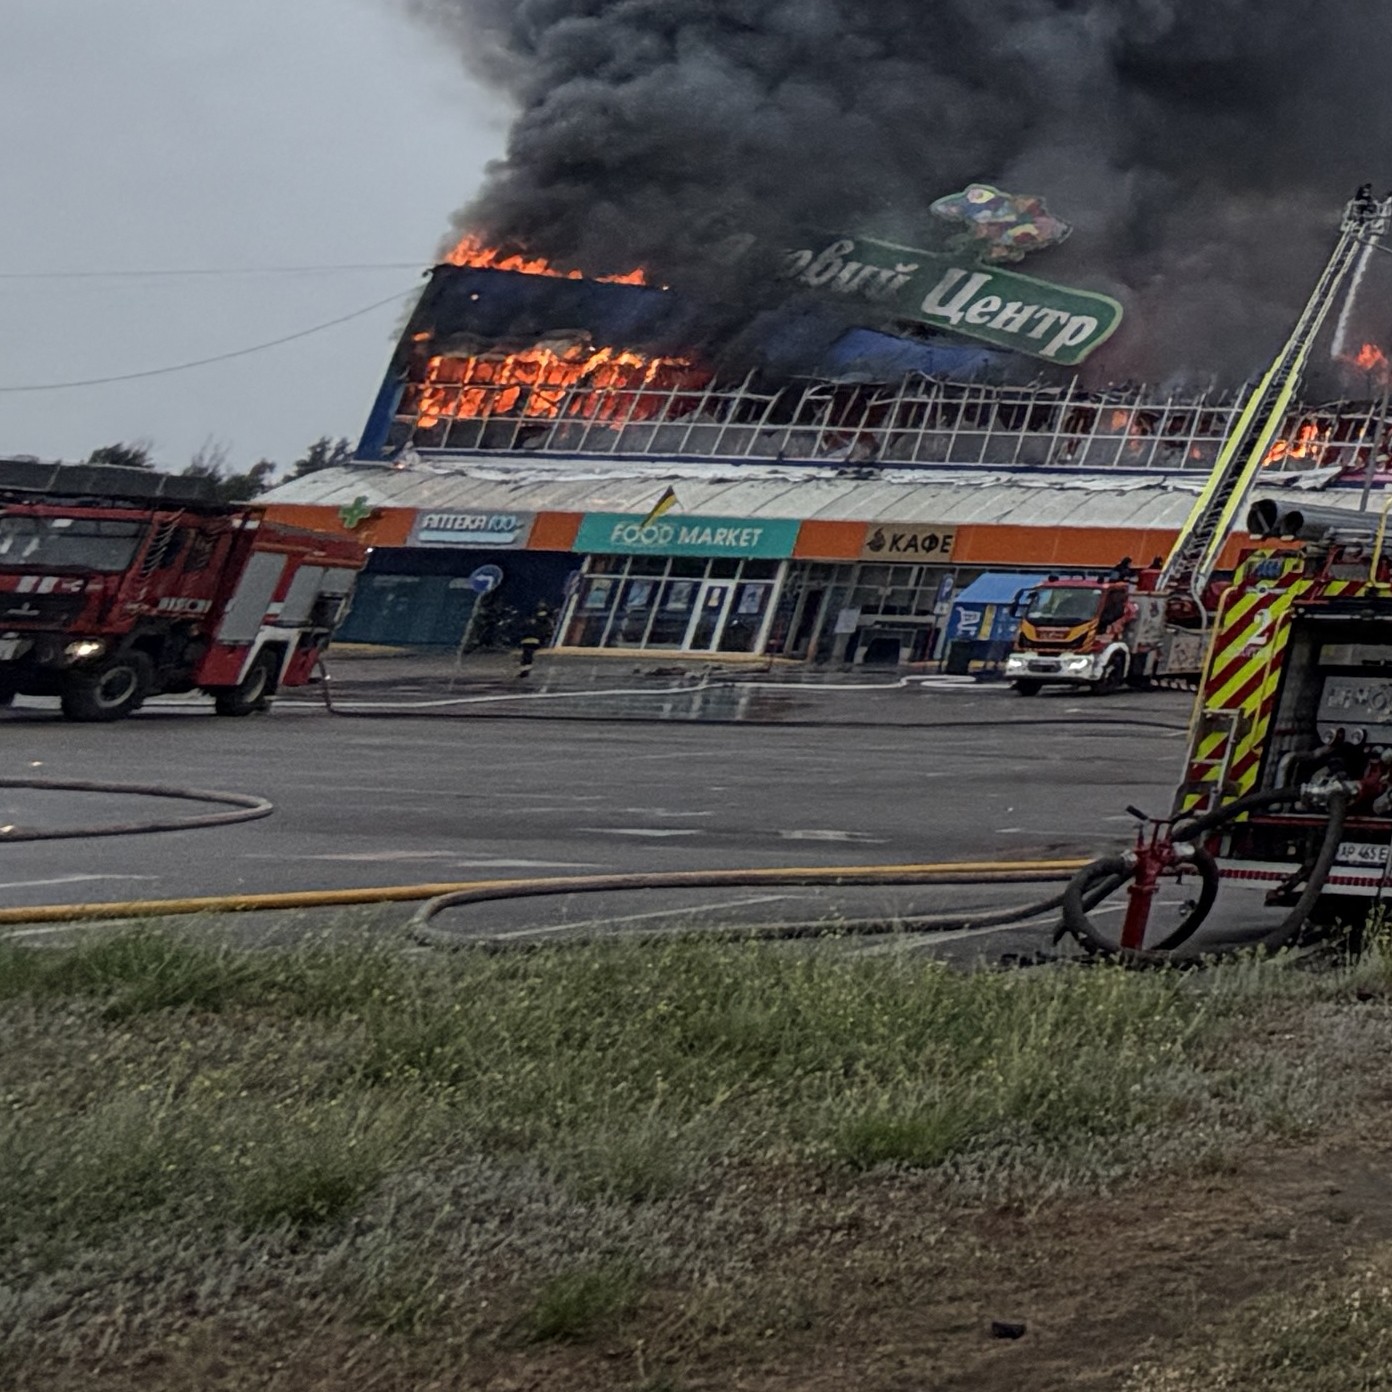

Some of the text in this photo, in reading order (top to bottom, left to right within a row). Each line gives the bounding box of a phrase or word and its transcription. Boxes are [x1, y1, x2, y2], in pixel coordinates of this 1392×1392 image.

[920, 268, 1099, 357] Центр
[611, 524, 764, 548] FOOD MARKET
[888, 533, 954, 554] КАФЕ
[1246, 608, 1273, 645] 2
